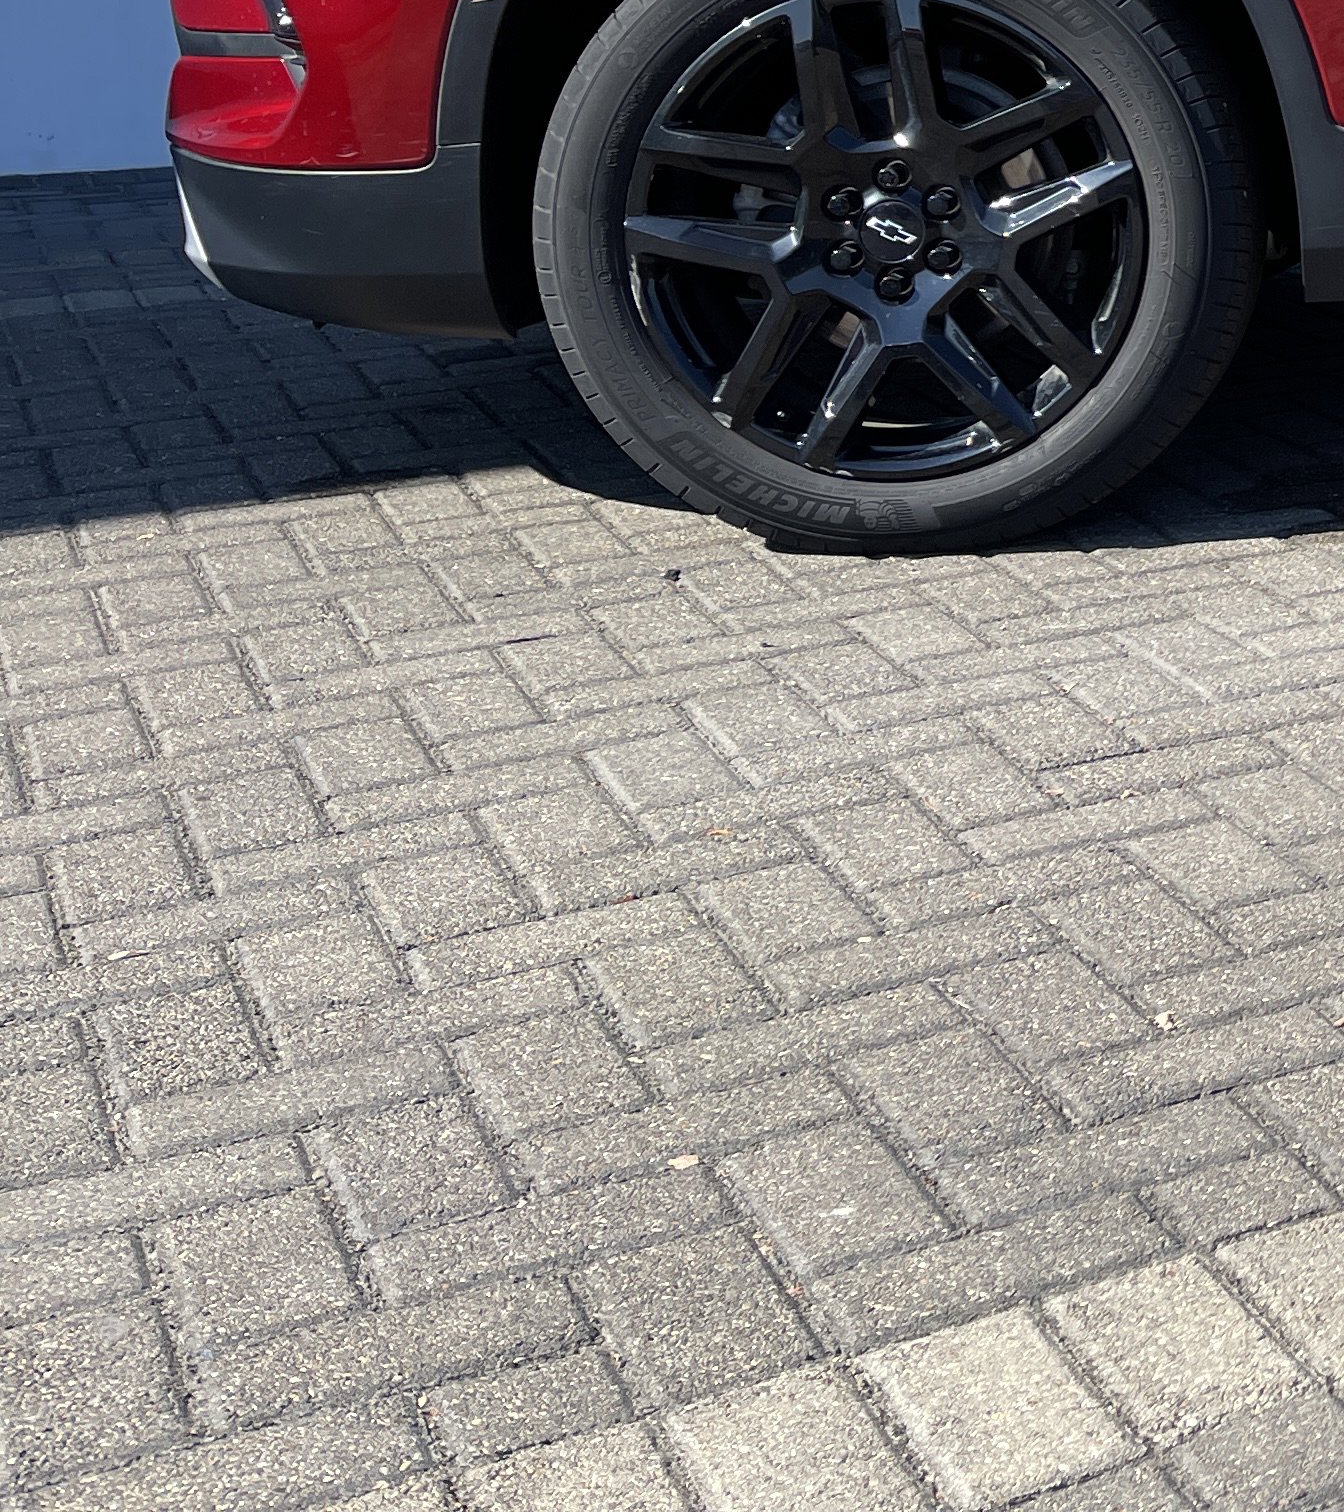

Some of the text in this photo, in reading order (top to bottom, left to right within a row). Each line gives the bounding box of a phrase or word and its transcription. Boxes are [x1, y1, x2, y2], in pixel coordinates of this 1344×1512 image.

[1164, 139, 1185, 168] 20
[568, 262, 599, 324] TOUR
[590, 335, 657, 427] PRIMACY
[671, 438, 850, 525] MICHELIN
